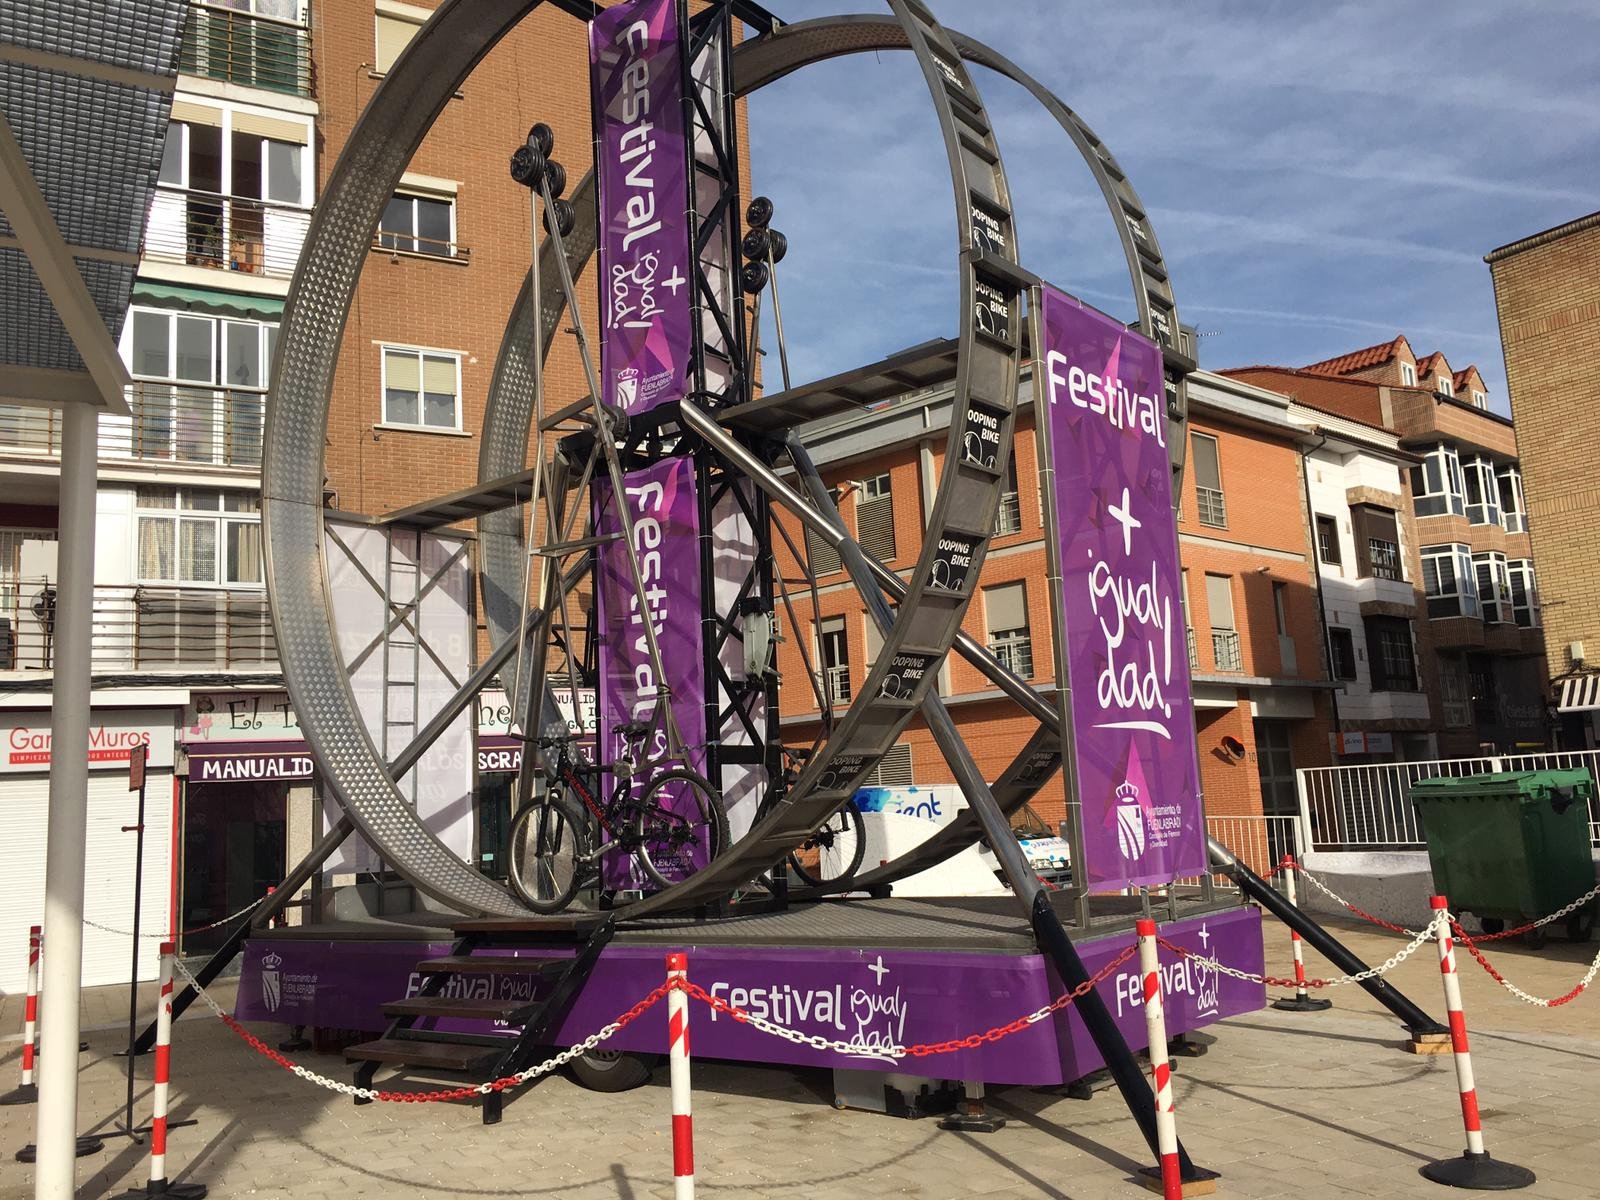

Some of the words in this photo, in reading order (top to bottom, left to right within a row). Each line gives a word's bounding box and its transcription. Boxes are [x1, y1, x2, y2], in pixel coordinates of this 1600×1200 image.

[616, 19, 662, 253] Festival
[986, 227, 1006, 247] BIKE
[990, 300, 1009, 318] BIKE
[1046, 349, 1166, 448] Festival
[981, 428, 1000, 445] BIKE
[950, 554, 971, 568] BIKE
[1087, 548, 1163, 648] igual
[902, 668, 924, 679] BIKE
[226, 696, 263, 730] El
[710, 981, 846, 1031] Festival
